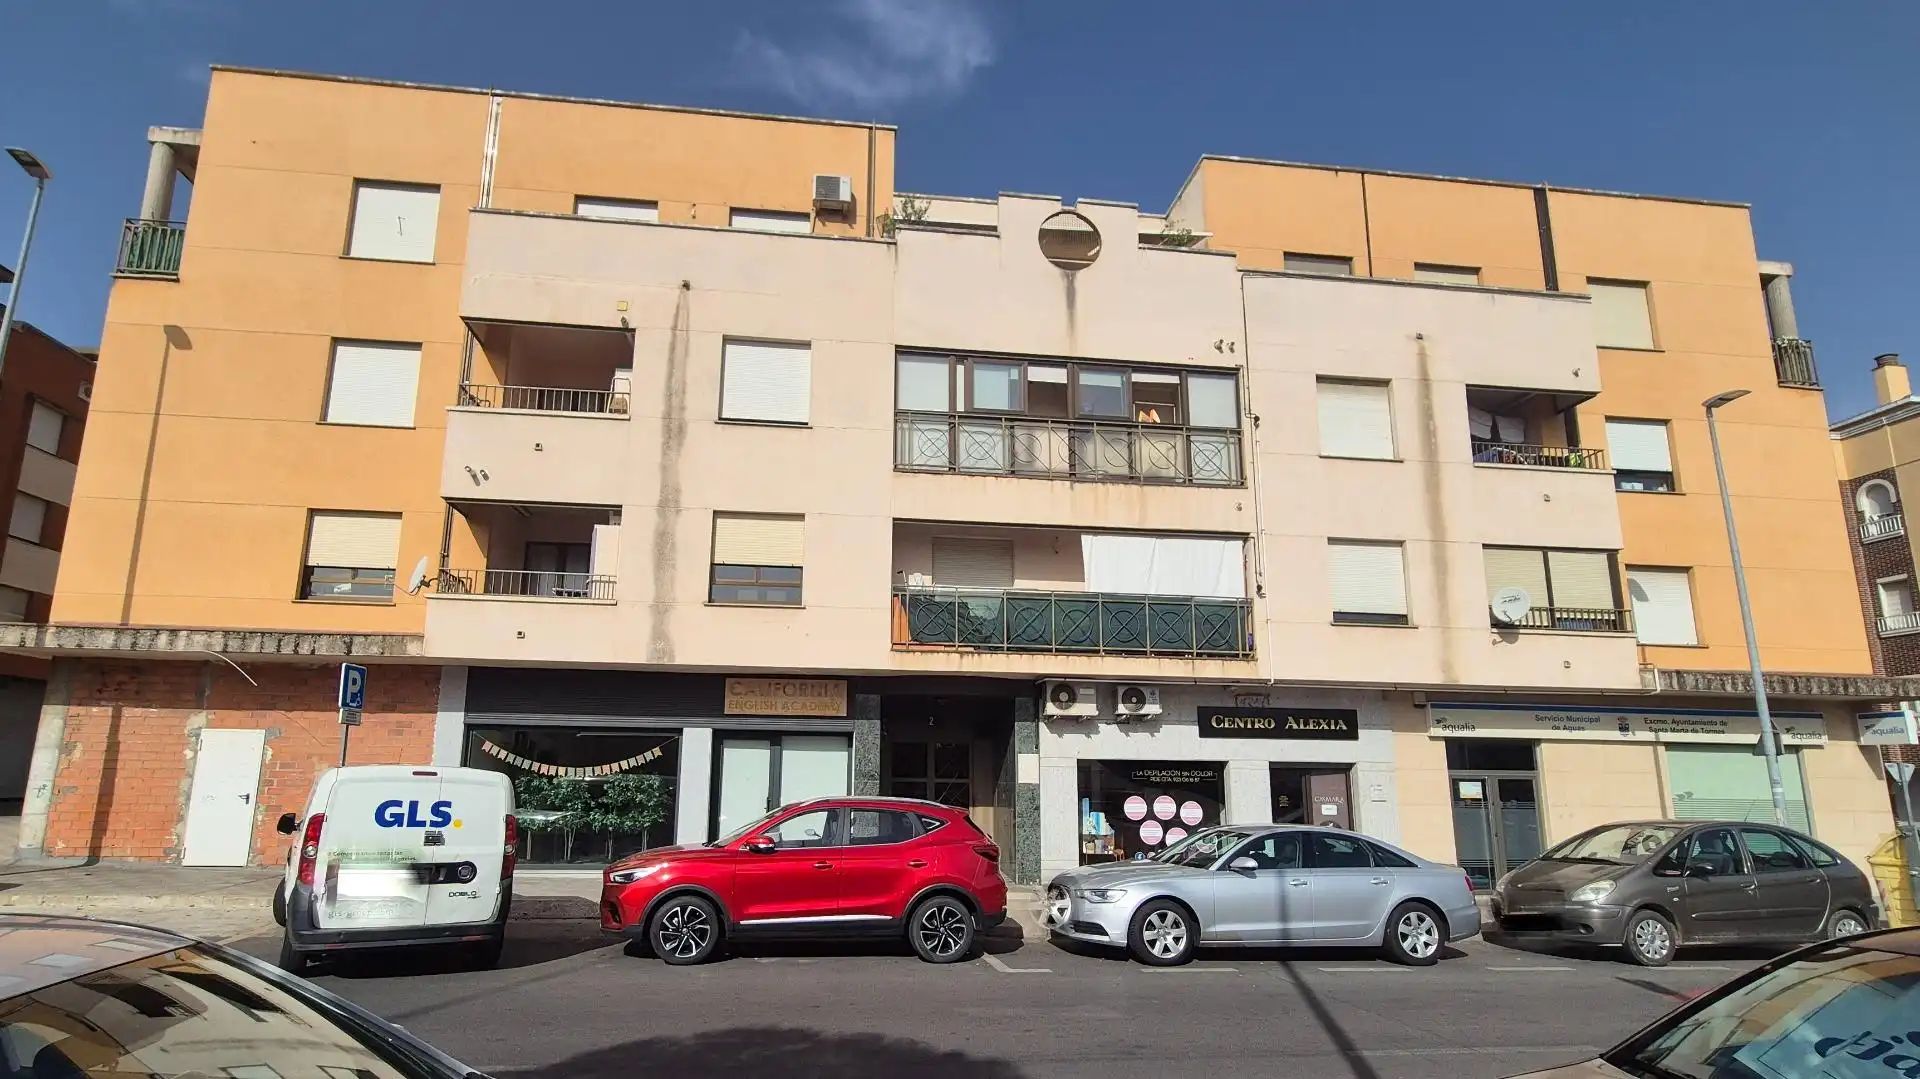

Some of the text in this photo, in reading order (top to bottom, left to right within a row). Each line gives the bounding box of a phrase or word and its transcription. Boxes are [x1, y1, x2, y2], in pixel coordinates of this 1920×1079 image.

[347, 670, 361, 703] P
[730, 680, 844, 697] CALIFORNIA
[728, 699, 842, 713] ENGLISH ACADEMY
[928, 717, 935, 725] 2
[1535, 714, 1601, 724] Servicio Municipal
[1644, 717, 1728, 728] Excmo. Ayuntamiento de
[1441, 722, 1476, 733] aqualia
[1563, 725, 1586, 733] Aguas
[1649, 726, 1668, 734] Santa
[1690, 727, 1699, 735] de
[1871, 726, 1905, 737] aqualia
[1791, 731, 1822, 742] aqualia
